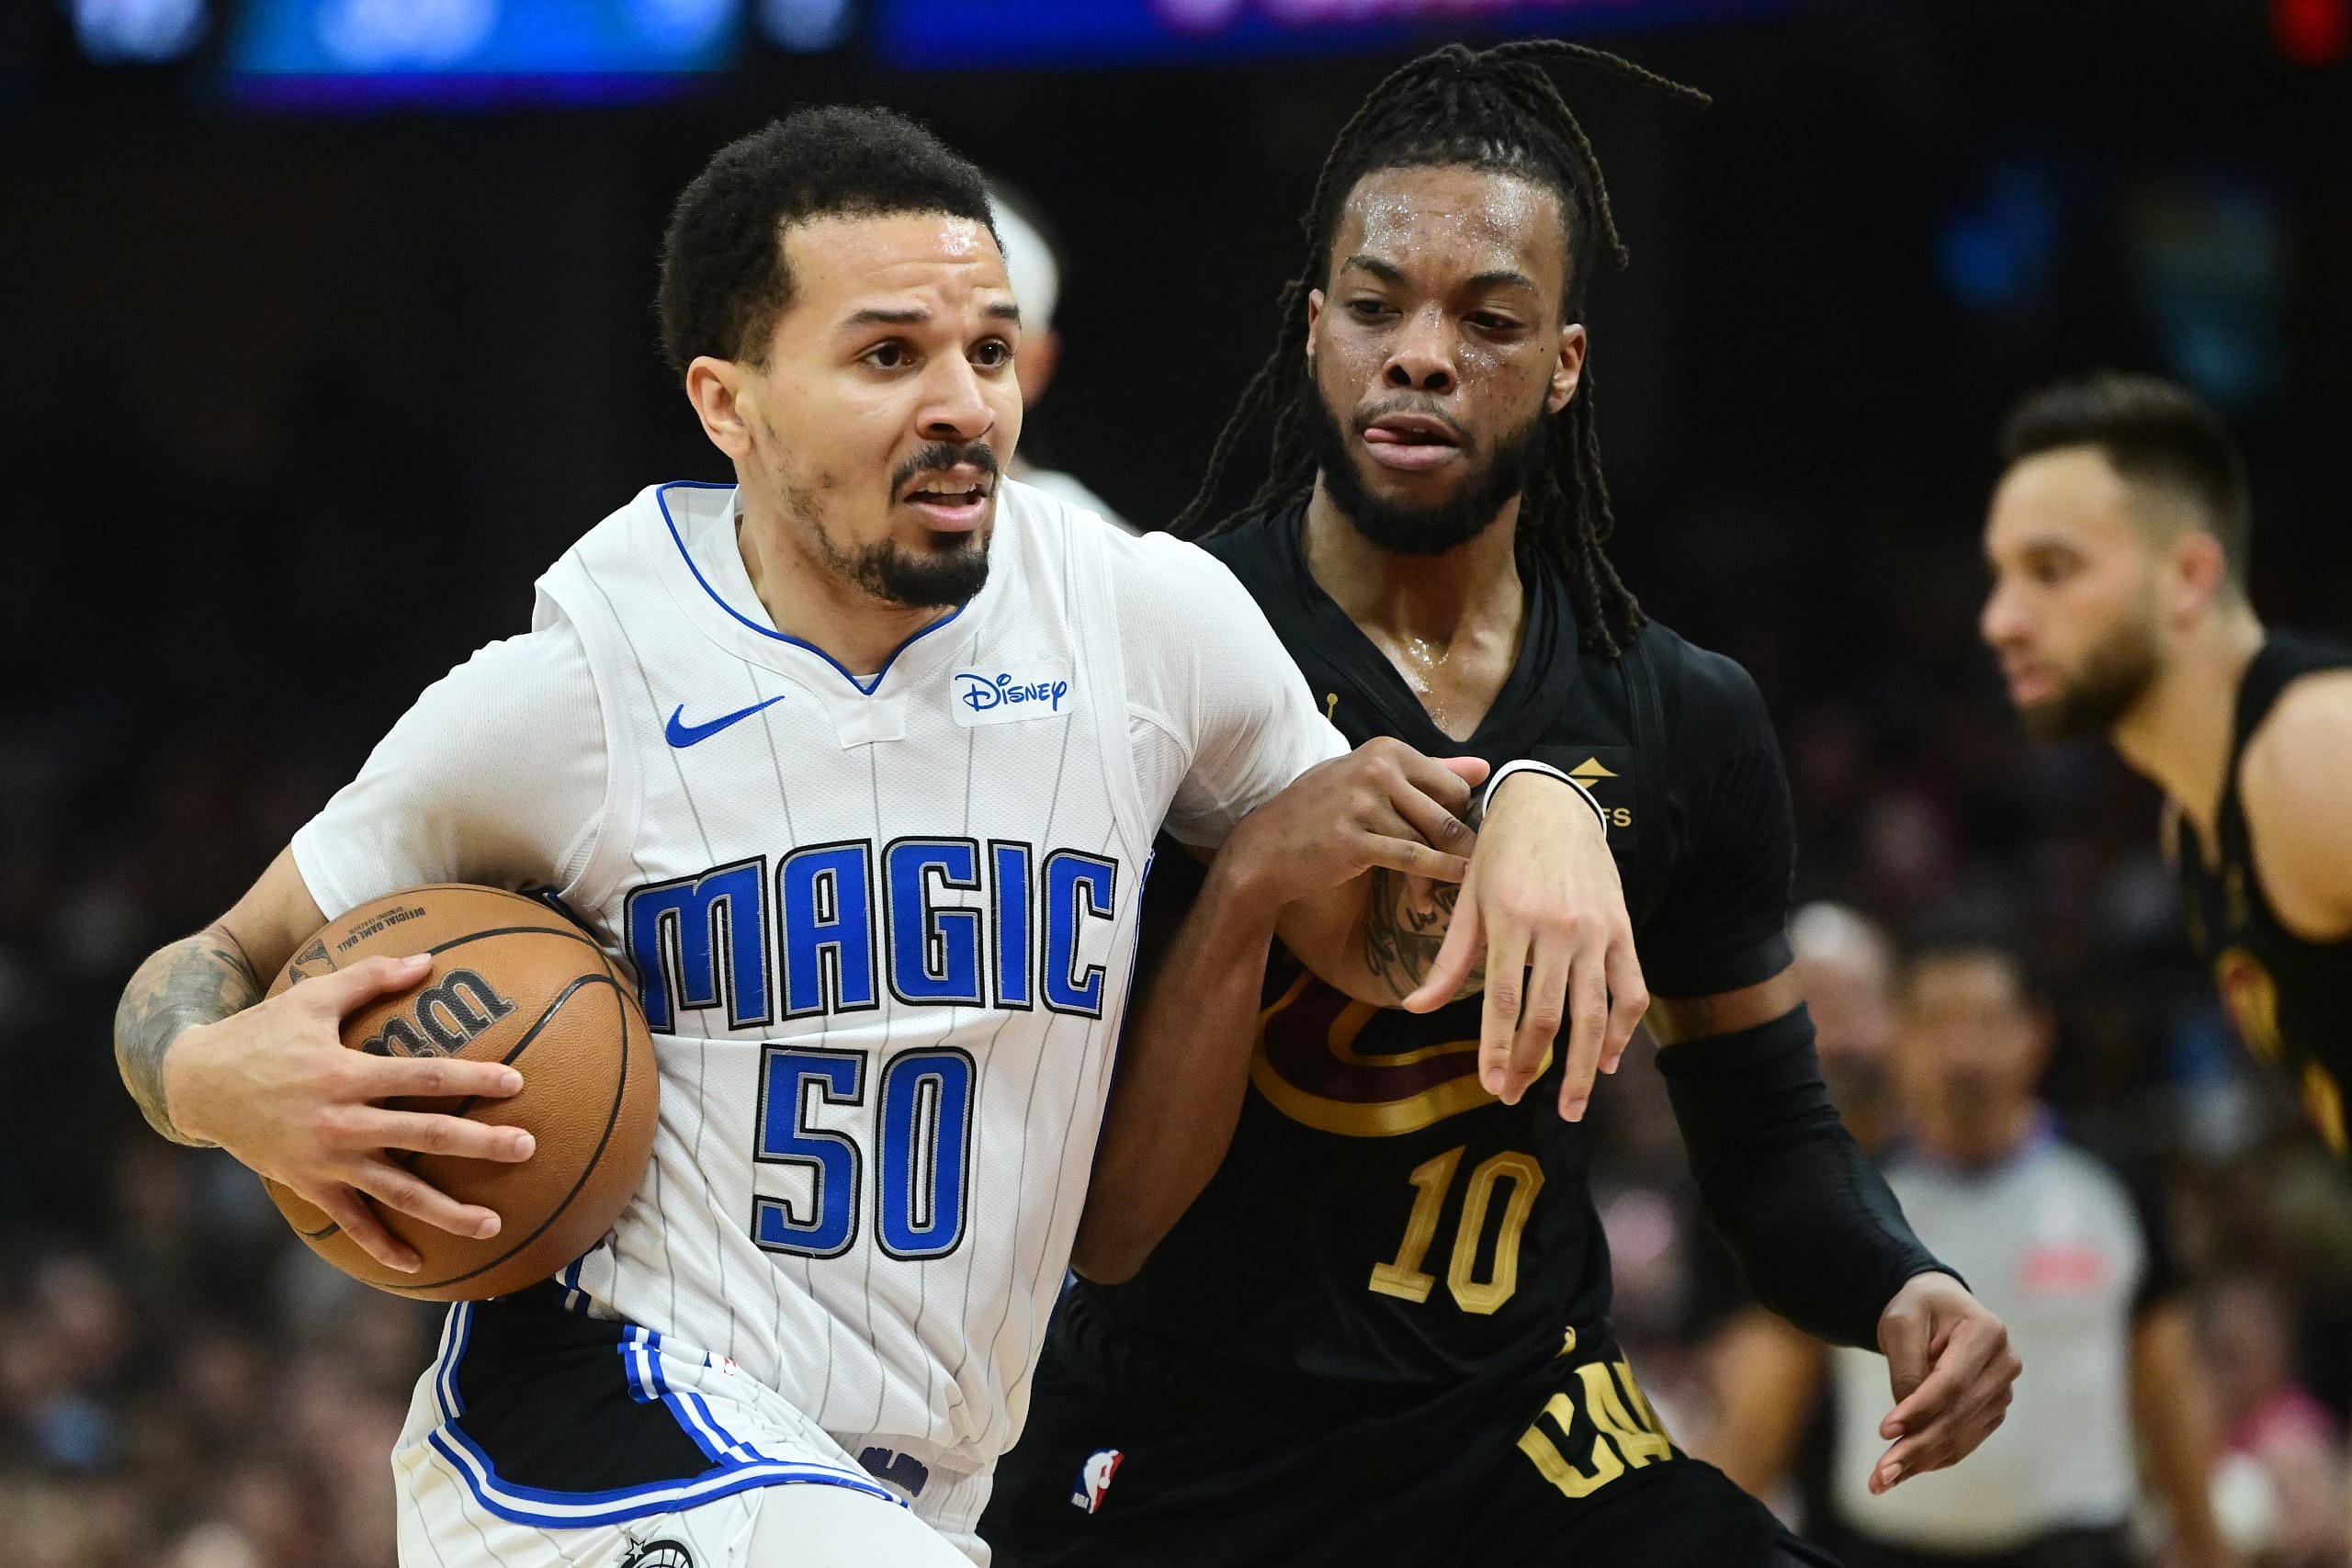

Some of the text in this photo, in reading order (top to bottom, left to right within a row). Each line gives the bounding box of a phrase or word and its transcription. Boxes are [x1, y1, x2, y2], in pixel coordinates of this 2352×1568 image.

[955, 673, 1068, 712] Disney
[623, 836, 1119, 1034] MAGIC
[750, 1043, 977, 1262] 50
[1368, 1145, 1545, 1315] 10
